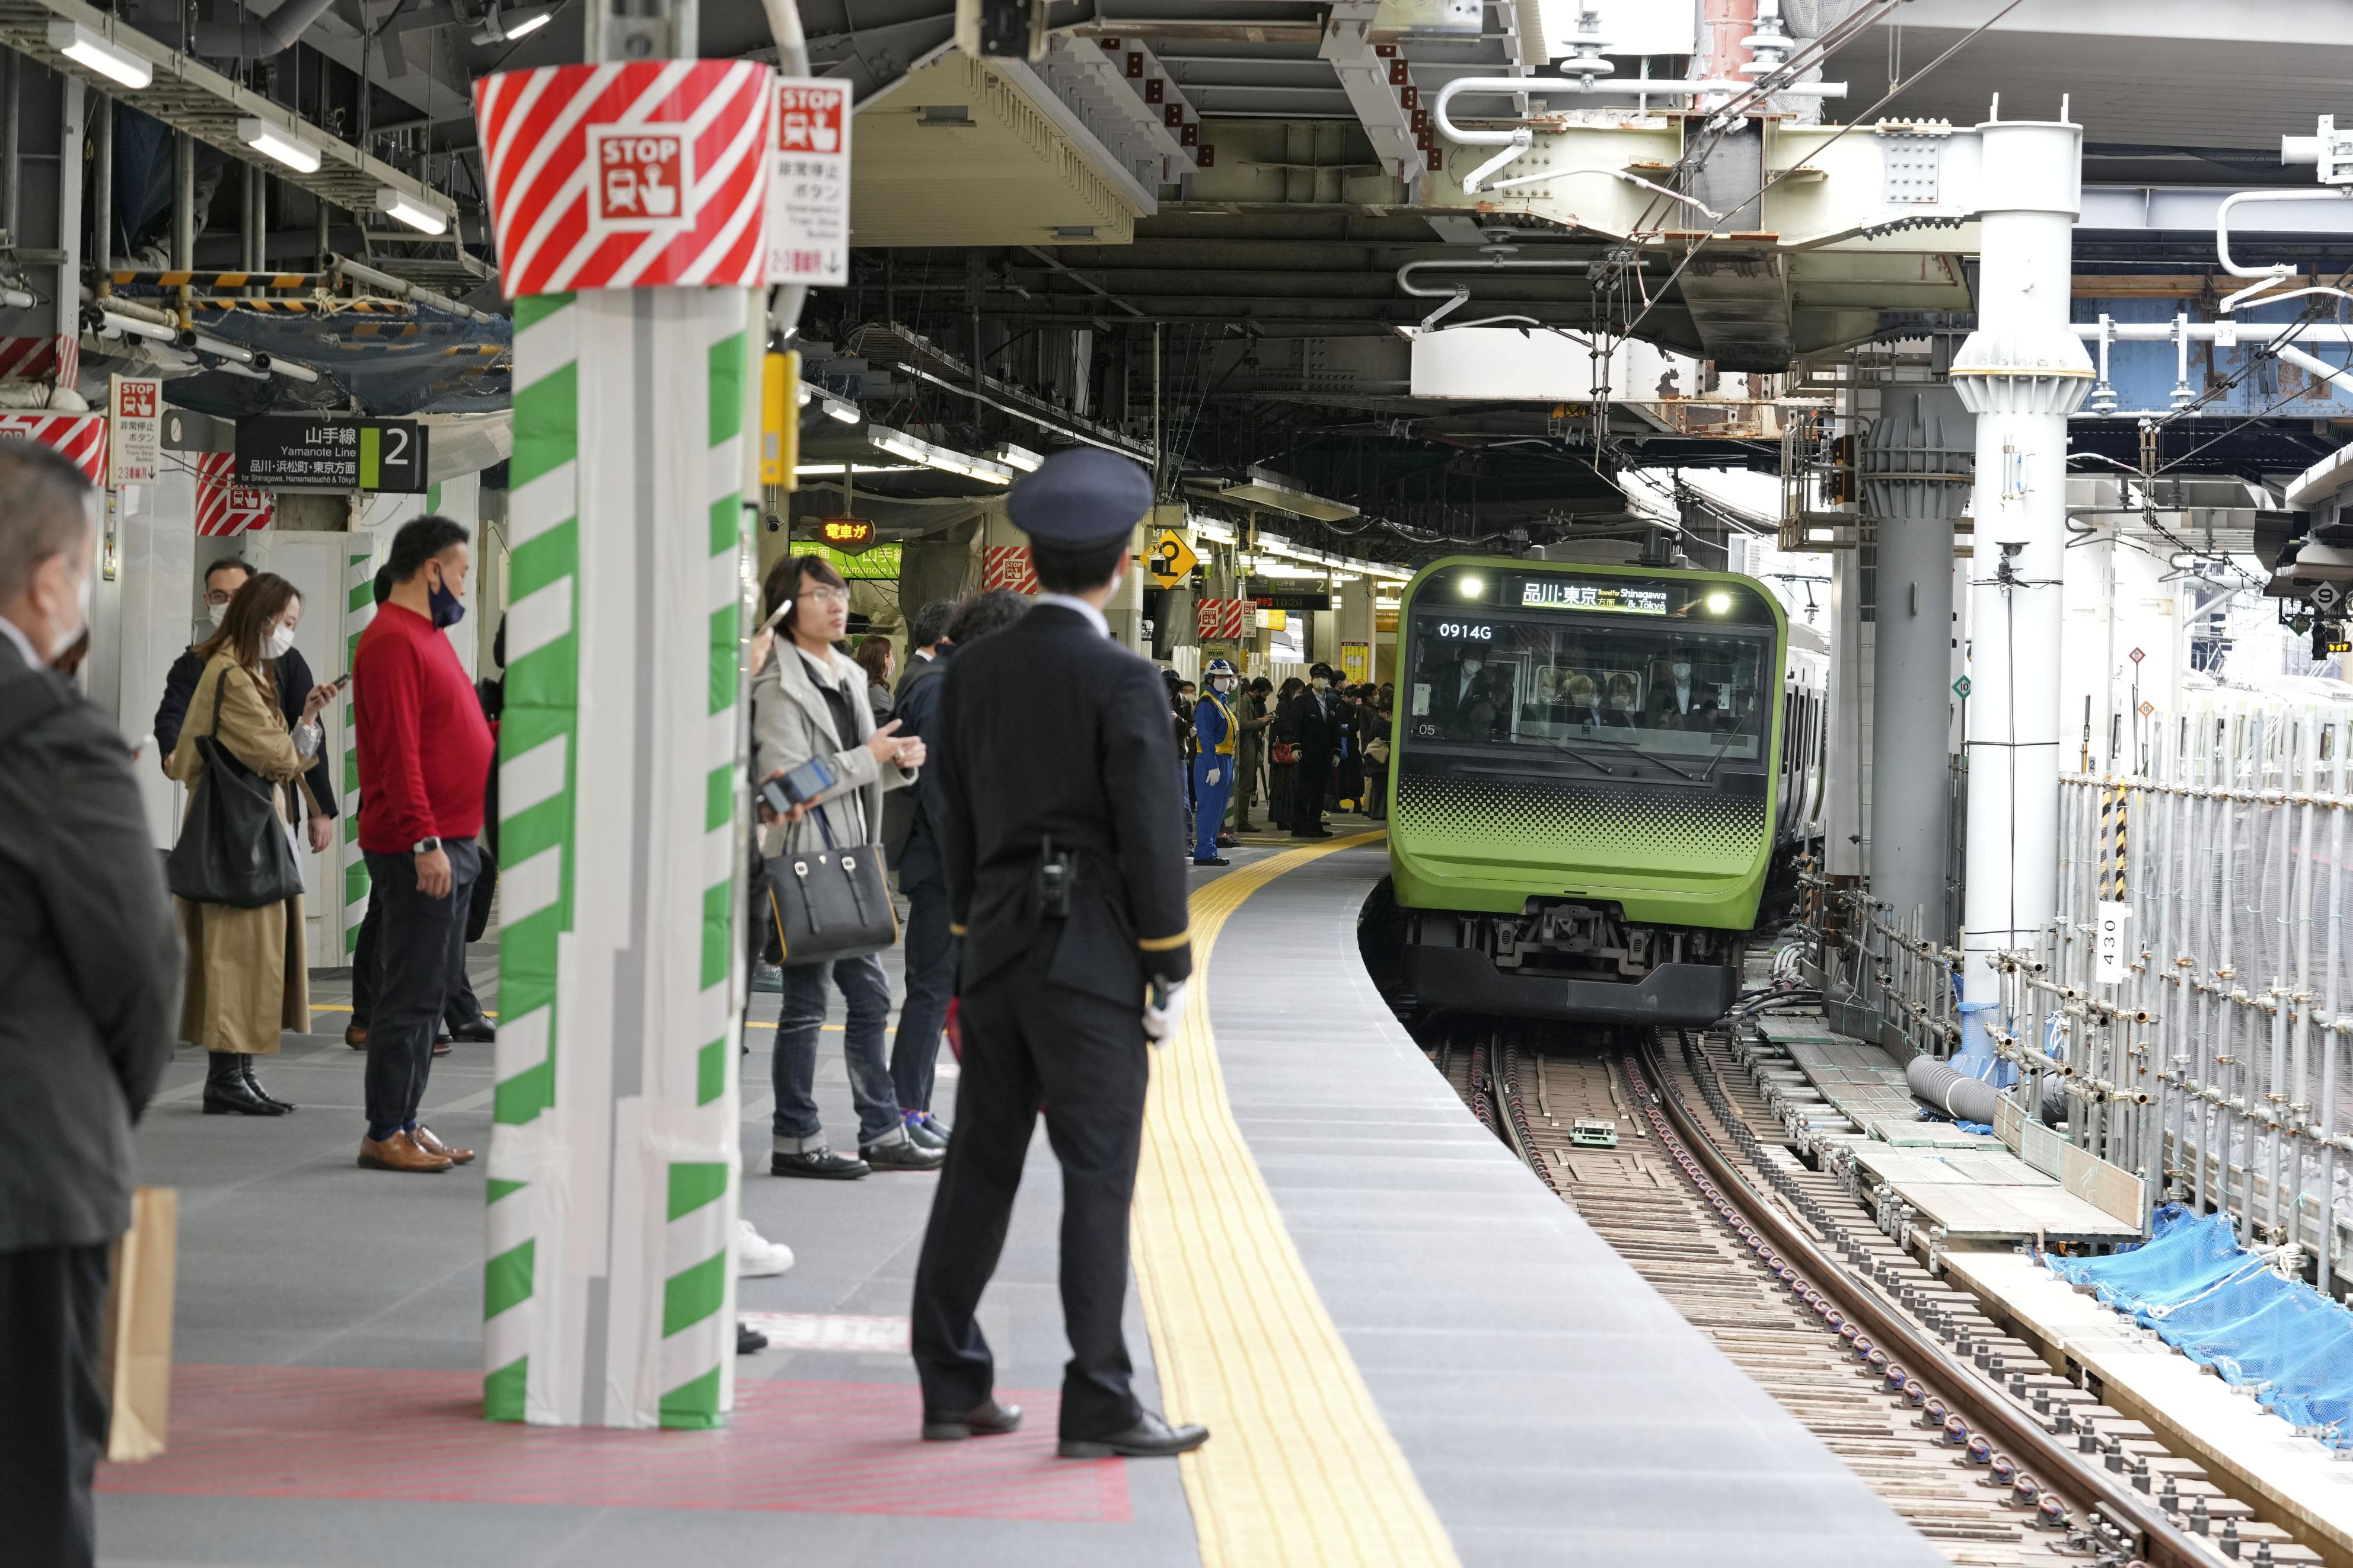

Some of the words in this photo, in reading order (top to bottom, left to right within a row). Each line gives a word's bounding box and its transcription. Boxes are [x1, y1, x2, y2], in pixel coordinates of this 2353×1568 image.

[782, 89, 840, 110] STOP
[603, 139, 678, 165] STOP
[123, 384, 154, 394] STOP
[120, 421, 154, 432] 非常停止
[129, 433, 154, 442] ボタン
[306, 427, 356, 445] 山手線
[281, 446, 331, 456] Yamanote
[335, 448, 356, 456] Line
[385, 428, 409, 465] 2
[250, 460, 355, 474] 品川・浜松町・東京方面
[251, 474, 284, 483] Shinagawa,
[825, 523, 867, 539] 電車が
[839, 565, 887, 574] Yamanote
[1316, 580, 1324, 592] 2
[1523, 583, 1598, 606] 品川・東京
[1620, 588, 1666, 601] Shinagawa
[2318, 589, 2333, 603] 9
[1275, 598, 1302, 607] 10:20
[1598, 598, 1615, 608] 方面
[1627, 599, 1636, 608] &
[1638, 600, 1666, 612] Tōkyō
[1440, 624, 1491, 639] 0914G
[1419, 724, 1435, 735] 05
[2090, 759, 2095, 769] 2
[2104, 920, 2115, 965] 430
